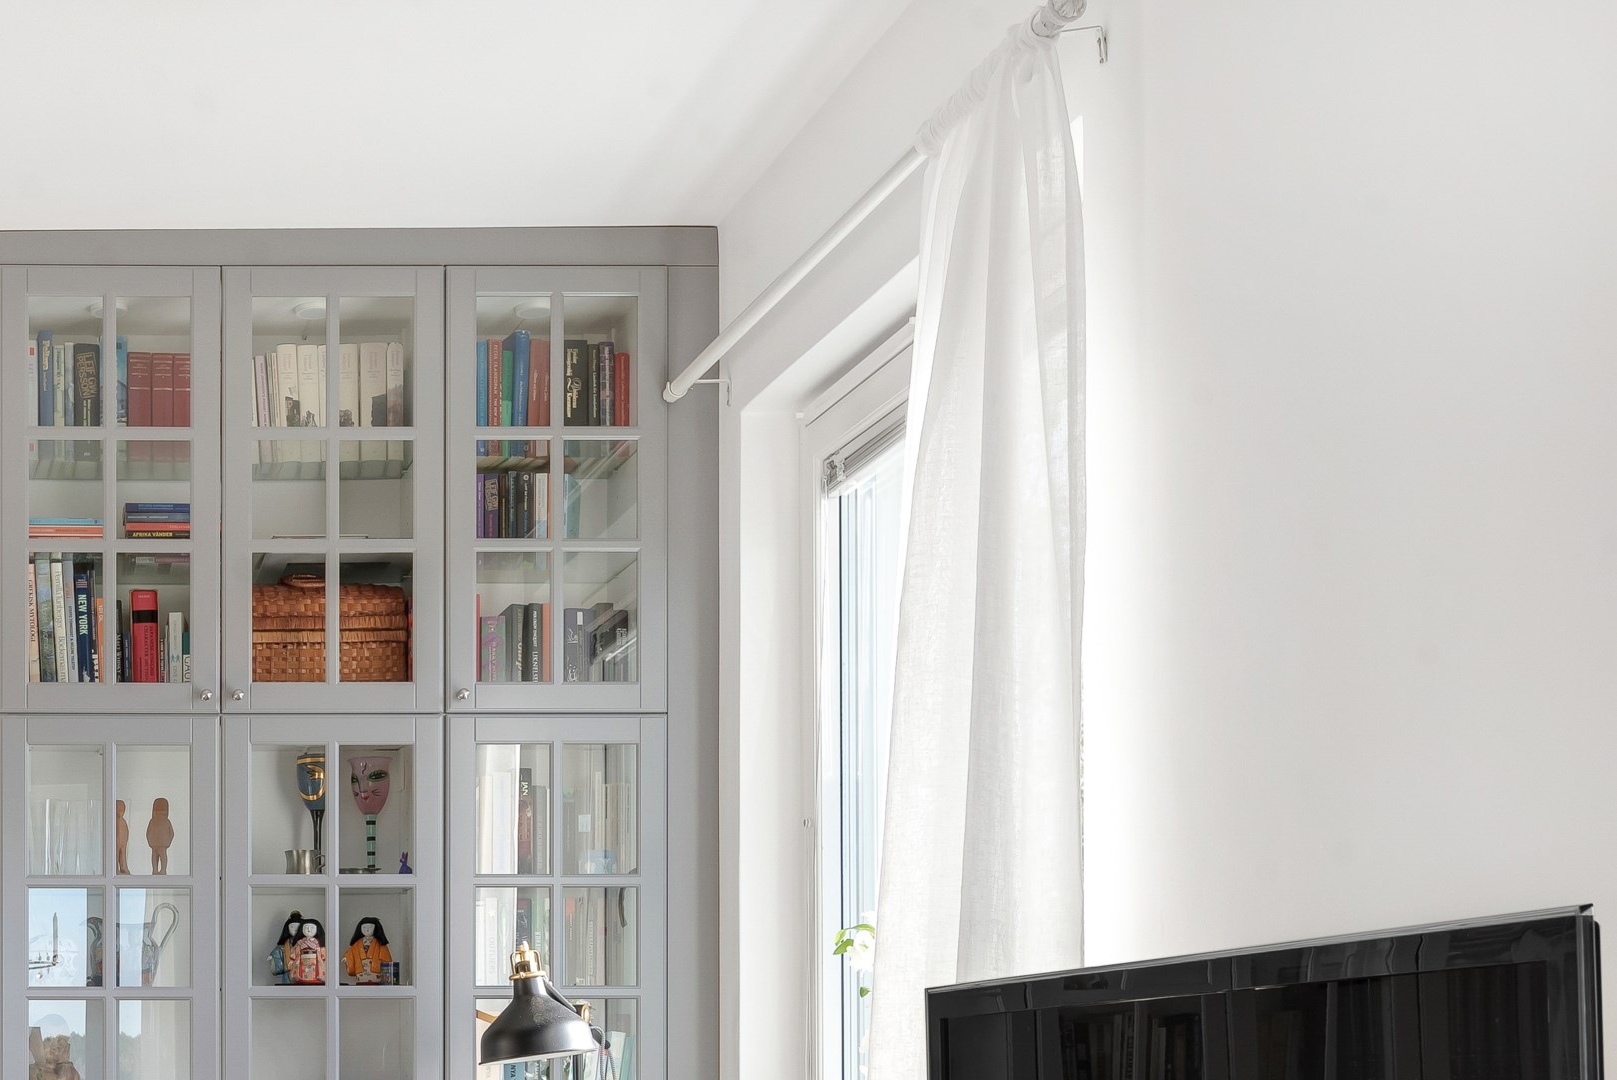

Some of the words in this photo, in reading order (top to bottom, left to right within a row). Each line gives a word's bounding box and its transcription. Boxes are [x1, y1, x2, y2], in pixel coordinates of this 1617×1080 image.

[84, 354, 95, 375] LEIF
[77, 356, 90, 397] PERSSON
[87, 377, 98, 394] GW
[78, 594, 88, 612] NEW
[78, 614, 89, 635] YORK
[521, 782, 529, 796] JAN
[509, 1064, 517, 1078] NYA
